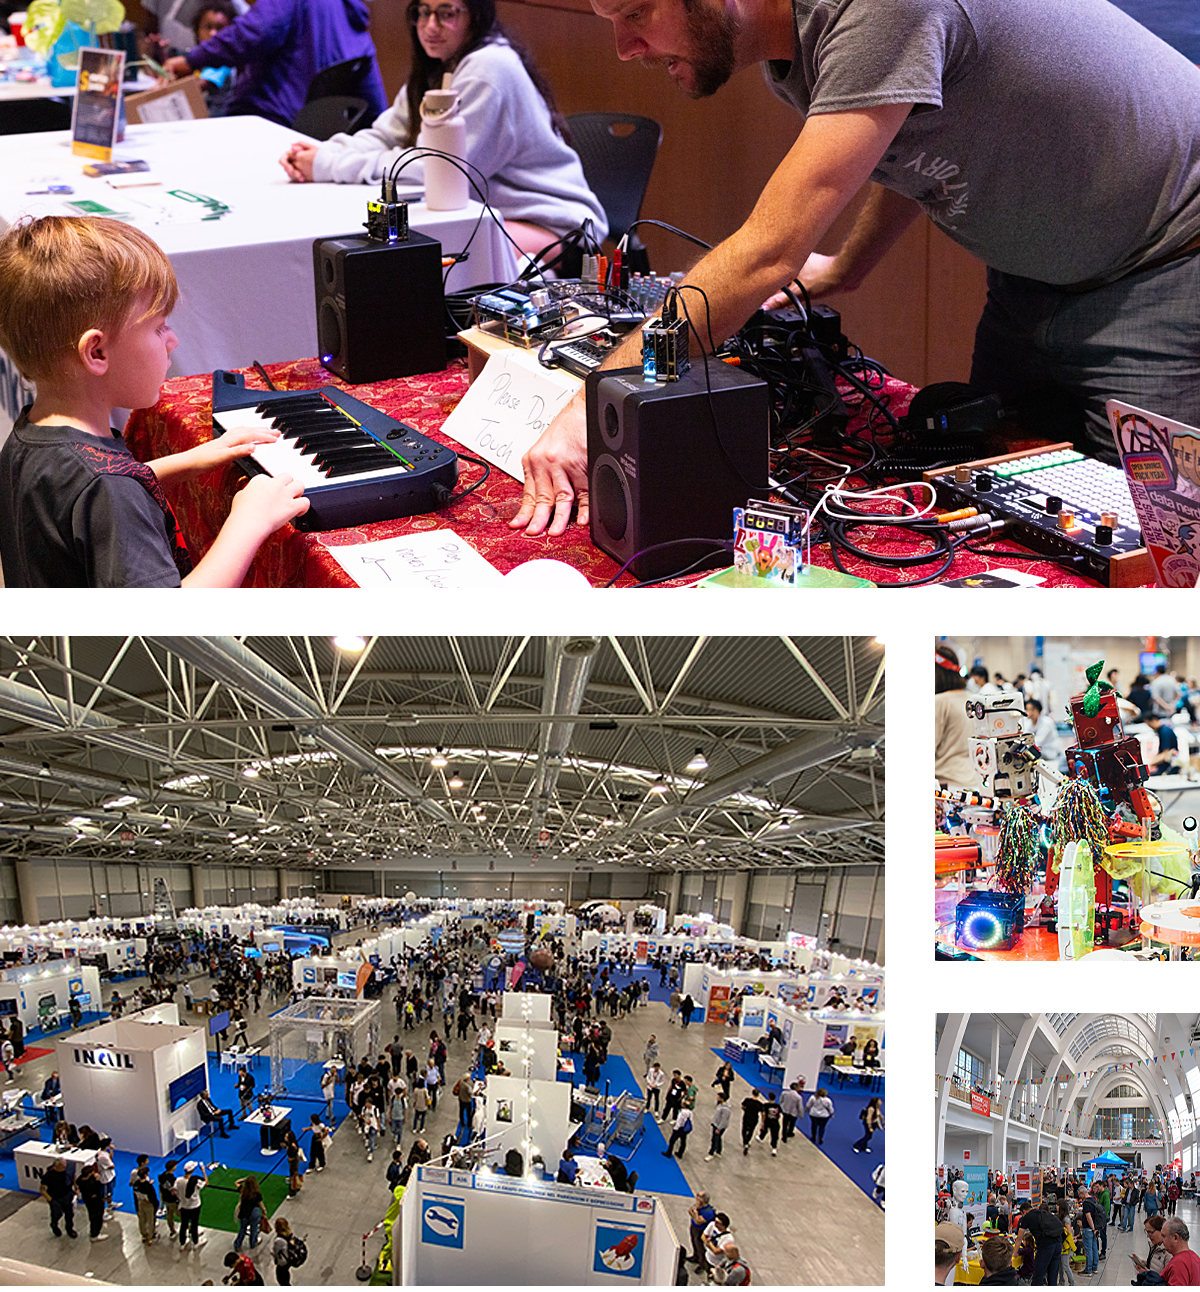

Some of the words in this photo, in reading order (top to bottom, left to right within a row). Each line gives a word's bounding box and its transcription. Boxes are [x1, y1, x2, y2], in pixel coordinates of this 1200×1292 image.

[488, 372, 521, 410] Please
[475, 418, 514, 465] Touch
[1130, 462, 1144, 471] OPEN
[1144, 462, 1163, 471] SOURCE
[1134, 471, 1150, 480] FUCK
[1150, 471, 1167, 480] YEAH
[1134, 481, 1148, 501] DOT
[1149, 490, 1175, 512] data
[1139, 513, 1158, 544] NEVER
[1151, 526, 1166, 542] THE
